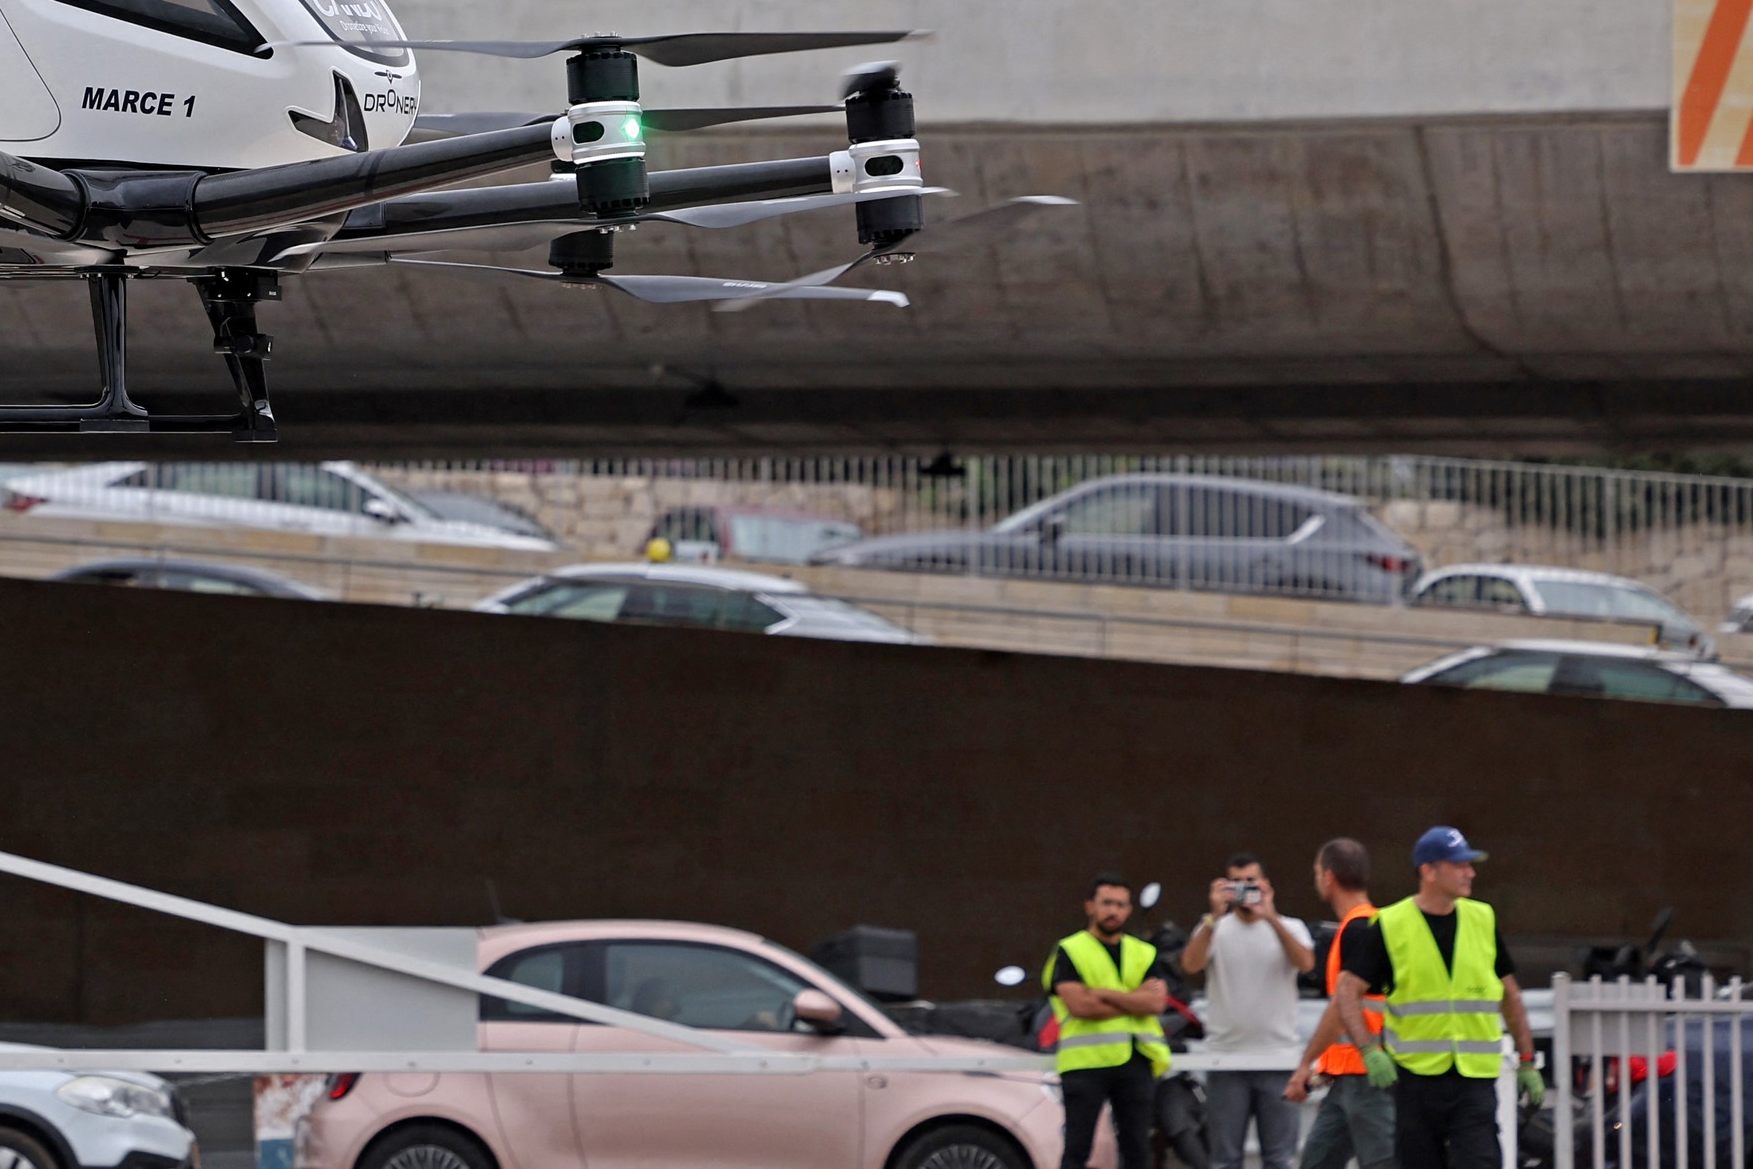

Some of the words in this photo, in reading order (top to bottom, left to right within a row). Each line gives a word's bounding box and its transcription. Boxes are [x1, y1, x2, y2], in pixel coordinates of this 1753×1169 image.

[81, 86, 176, 117] MARCE
[183, 95, 196, 118] 1
[363, 88, 417, 115] DRONER
